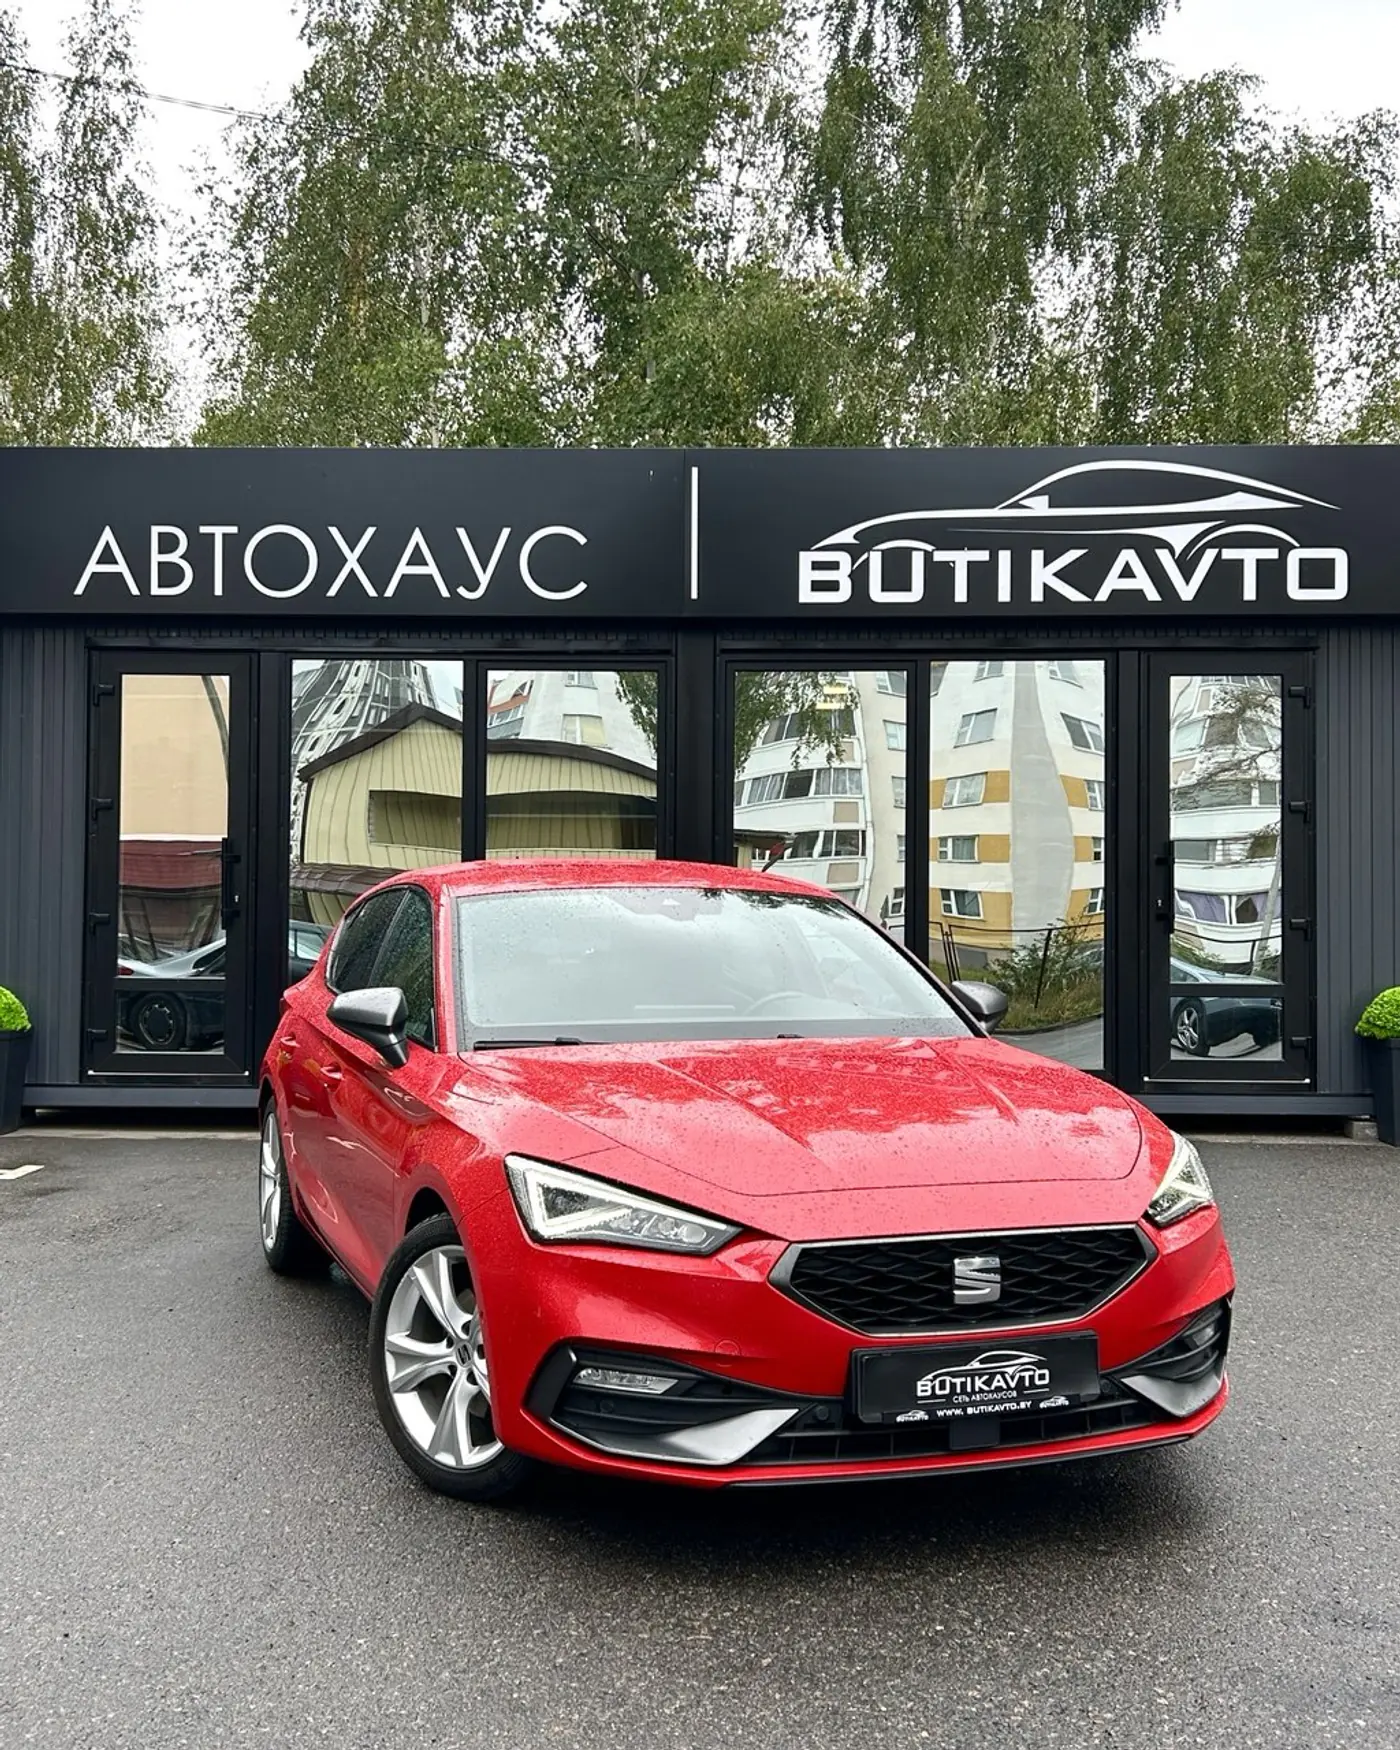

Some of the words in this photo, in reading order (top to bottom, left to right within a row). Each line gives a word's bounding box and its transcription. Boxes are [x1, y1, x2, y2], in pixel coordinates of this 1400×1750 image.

[73, 525, 588, 600] АВТОХАУС
[799, 547, 1349, 603] BUTIKAVTO
[917, 1370, 1050, 1397] BUTIKAVTO
